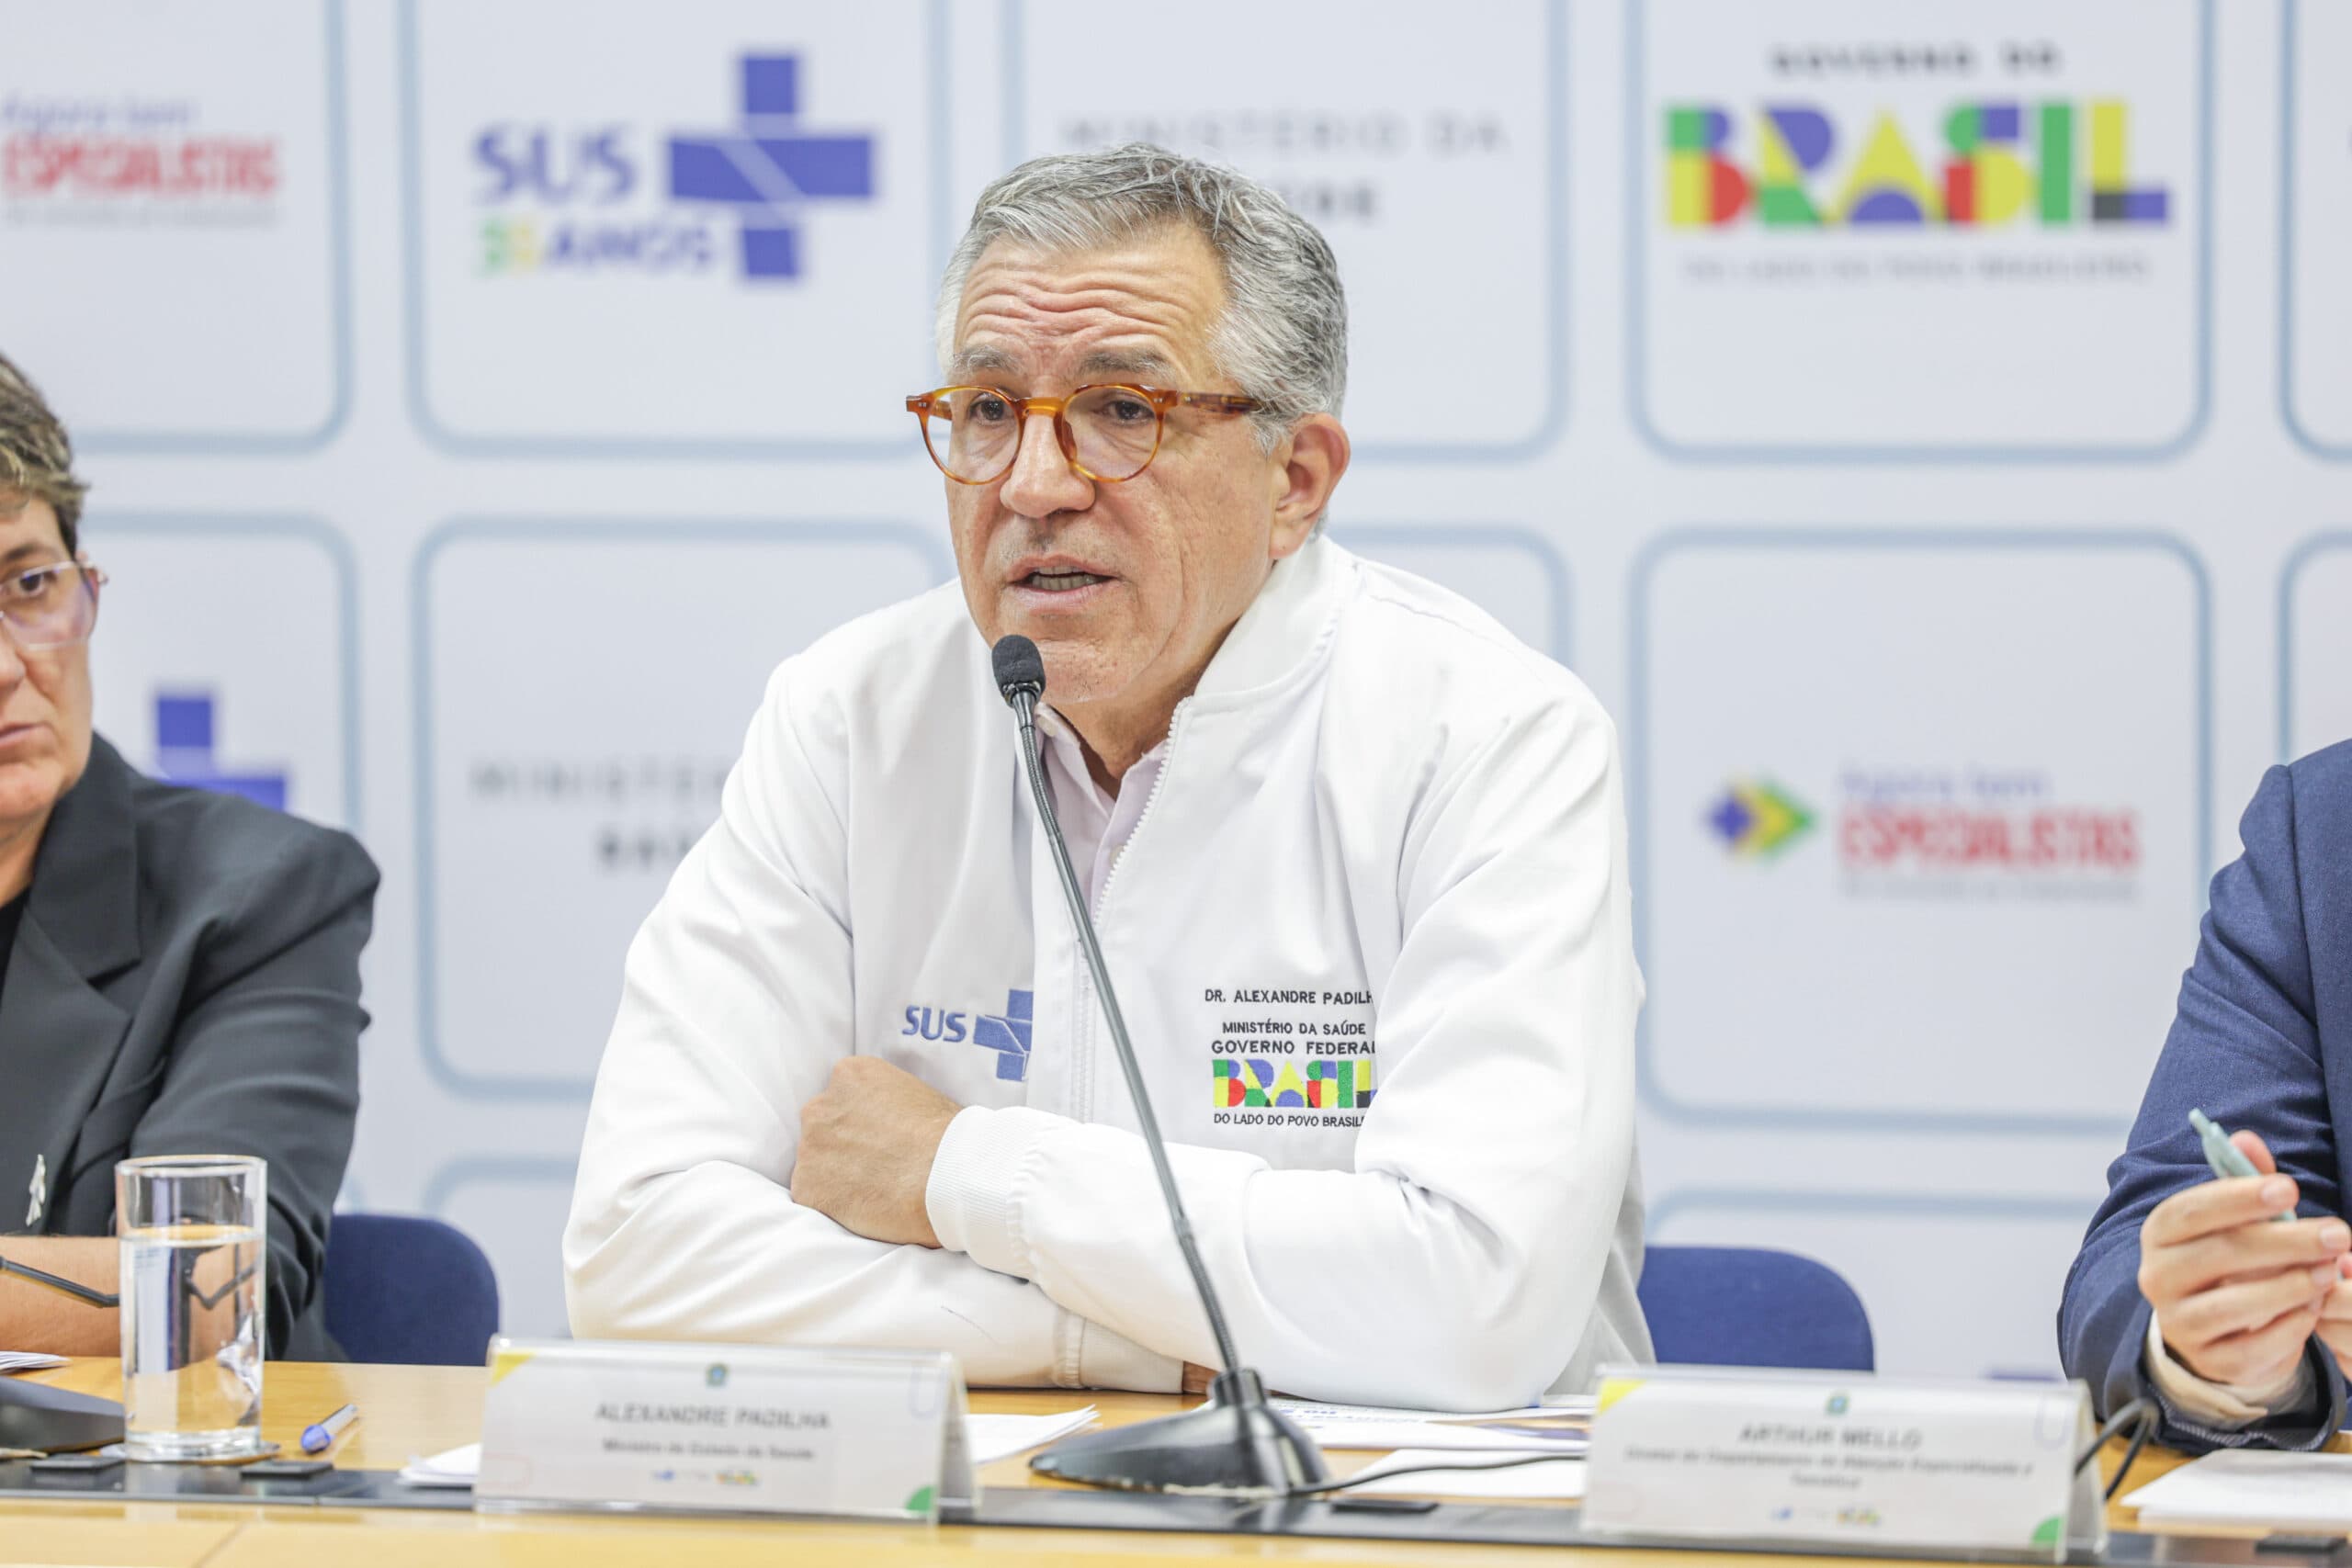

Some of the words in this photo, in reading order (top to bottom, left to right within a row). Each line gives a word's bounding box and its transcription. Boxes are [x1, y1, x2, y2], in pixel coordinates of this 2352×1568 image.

[474, 128, 636, 205] SUS
[1667, 102, 2169, 226] BRASIL
[1204, 988, 1227, 1002] DR.
[1233, 989, 1317, 1004] ALEXANDRE
[1323, 991, 1374, 1005] PADILH
[901, 1004, 967, 1043] SUS
[1222, 1018, 1294, 1034] MINISTÉRIO
[1298, 1021, 1317, 1035] DA
[1323, 1020, 1366, 1036] SAÚDE
[1211, 1040, 1295, 1055] GOVERNO
[1212, 1058, 1377, 1109] BRASIL
[1213, 1112, 1230, 1125] DO
[1233, 1113, 1264, 1125] LADO
[1267, 1114, 1284, 1126] DO
[1287, 1115, 1319, 1127] POVO
[1322, 1116, 1365, 1128] BRASIL
